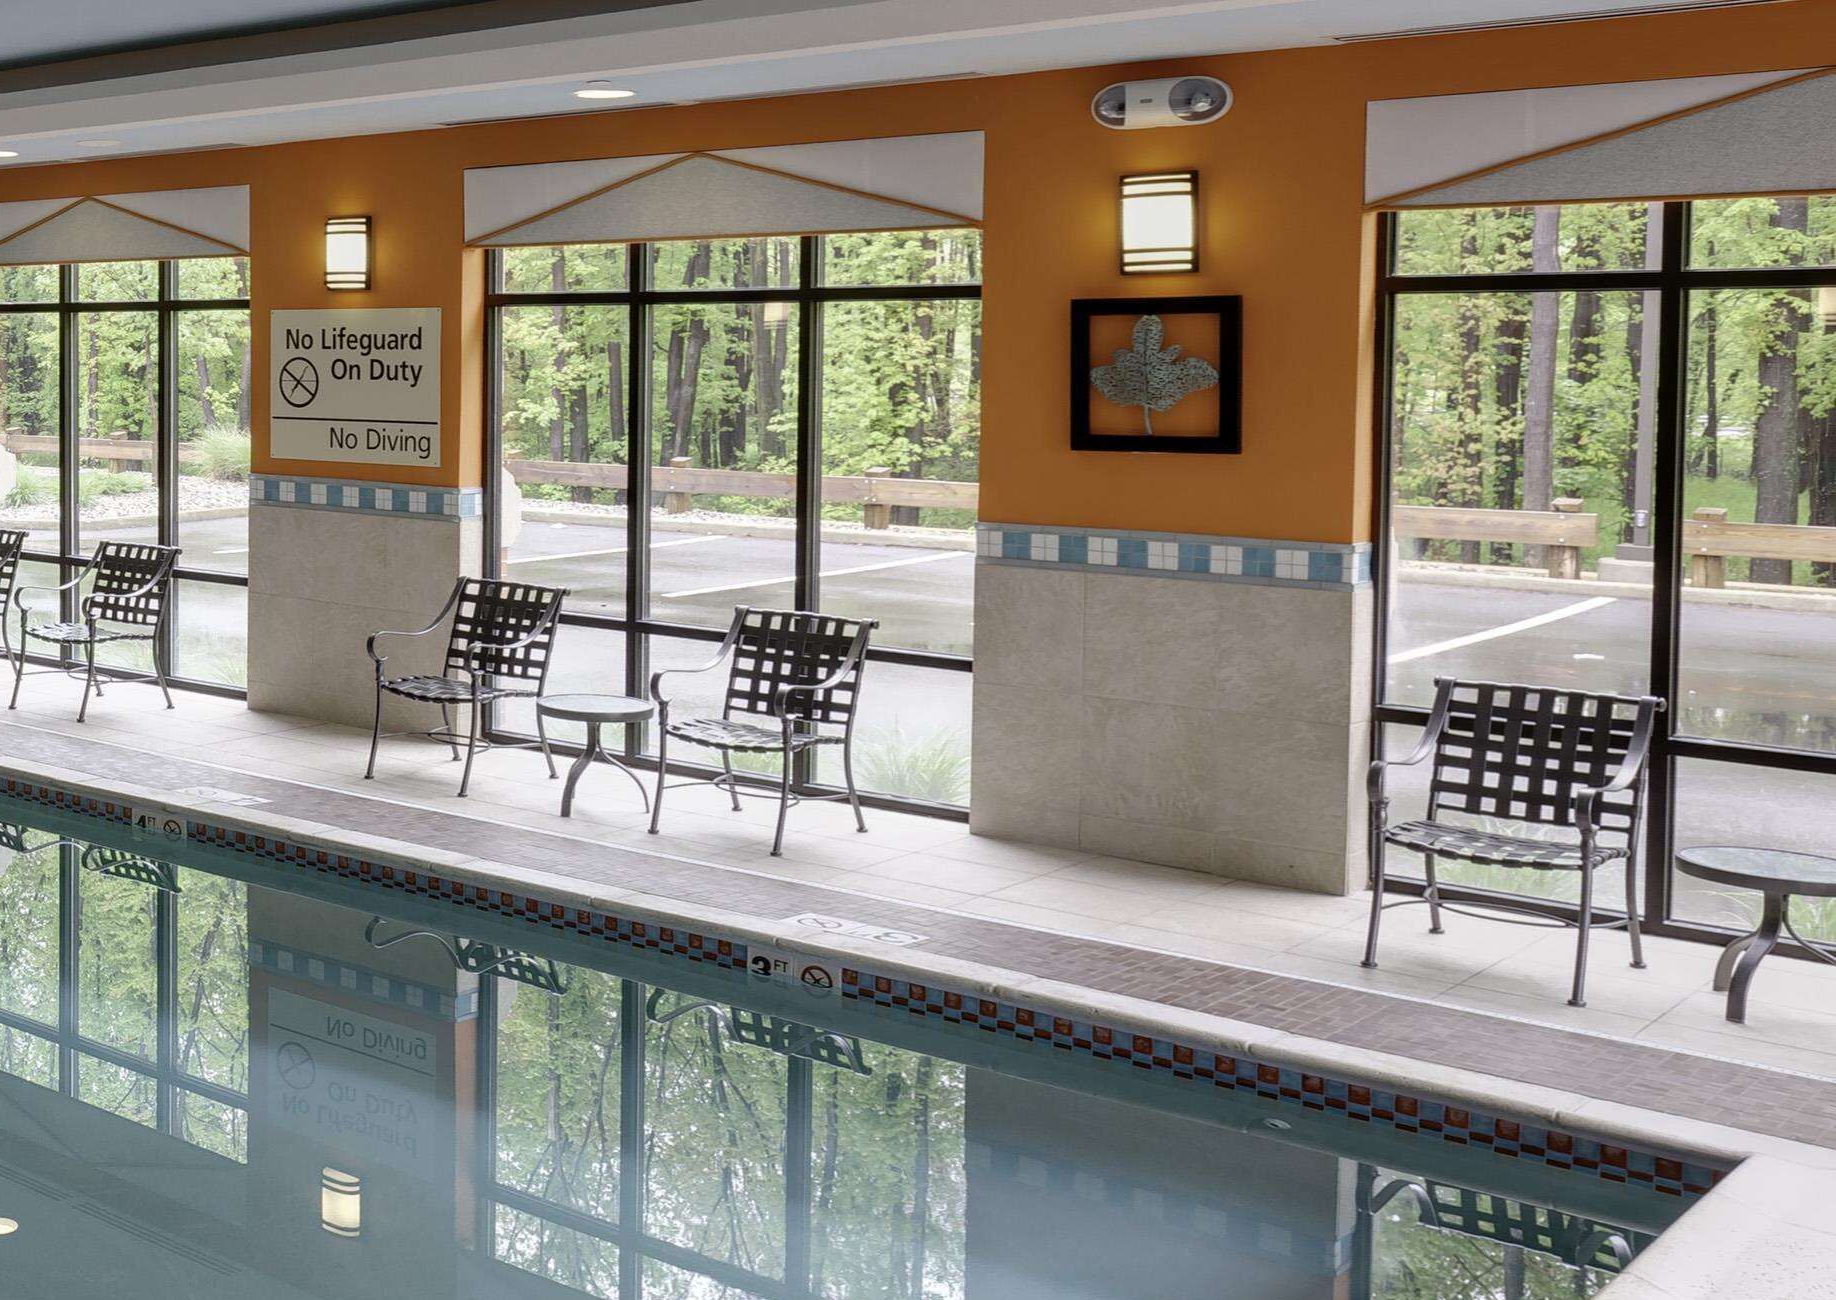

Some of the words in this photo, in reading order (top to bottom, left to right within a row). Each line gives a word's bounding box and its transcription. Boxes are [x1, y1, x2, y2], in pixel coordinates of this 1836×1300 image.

[285, 328, 313, 351] No
[321, 326, 423, 356] Lifeguard
[331, 358, 361, 381] On
[370, 359, 423, 388] Duty
[329, 427, 358, 449] No
[366, 428, 431, 460] Diving
[773, 959, 789, 973] FT
